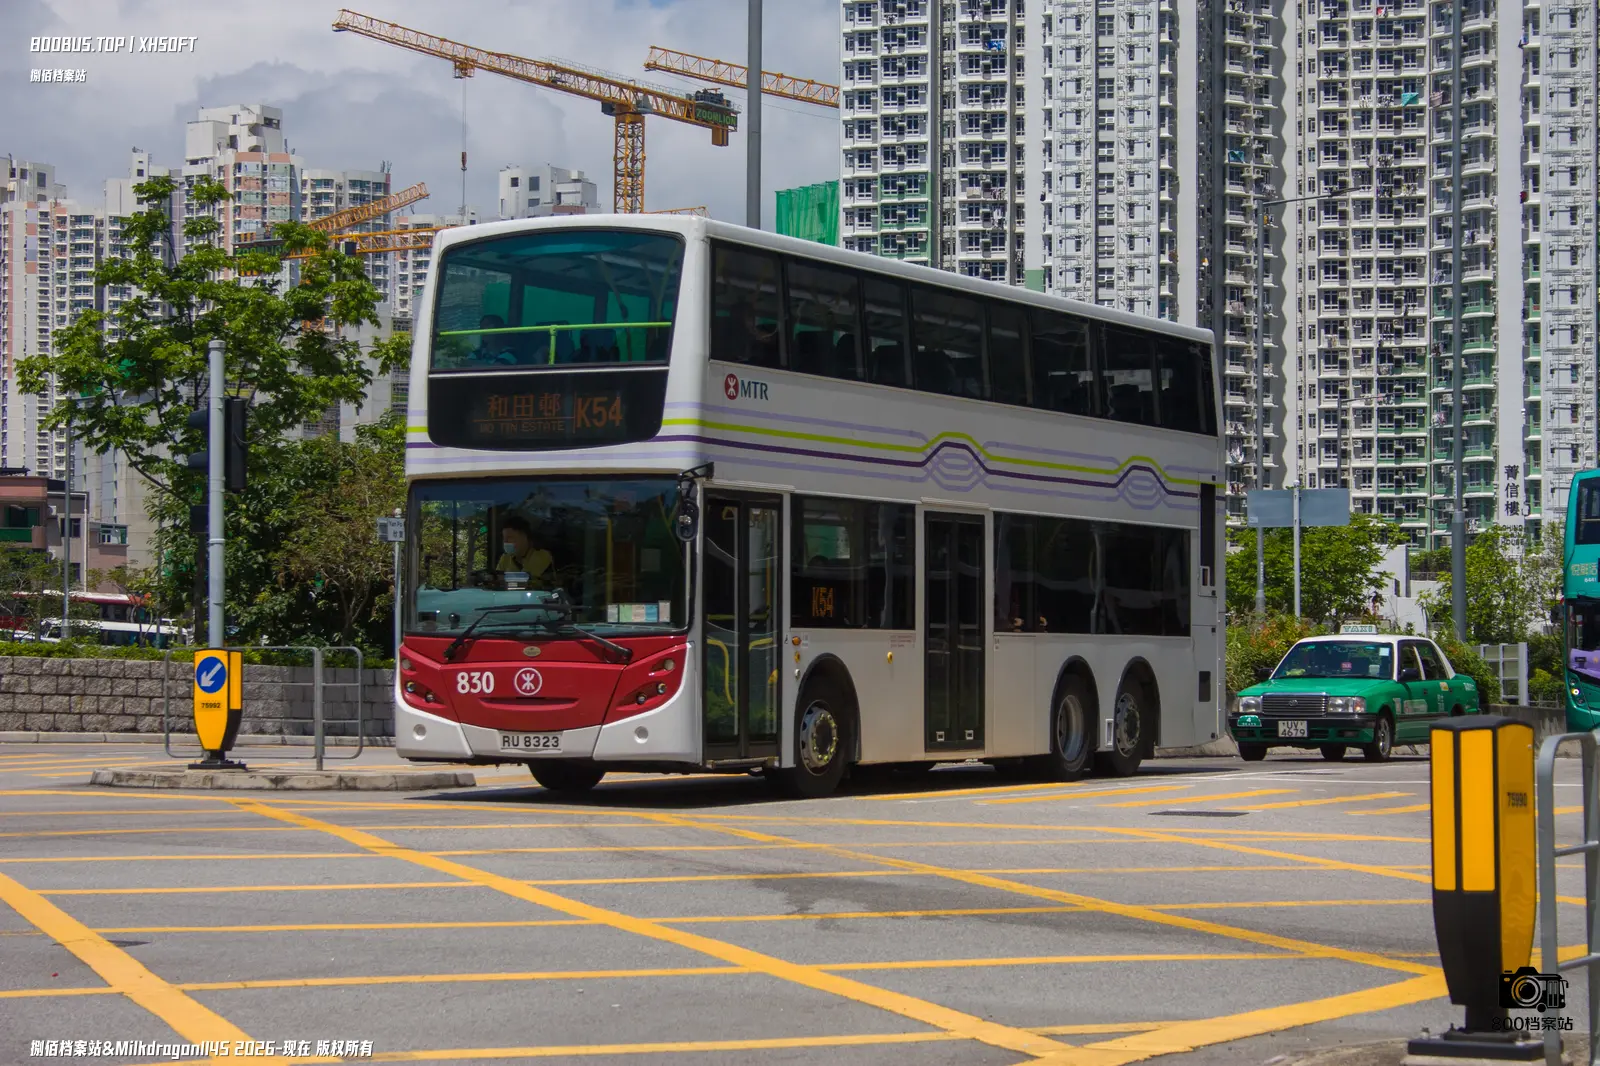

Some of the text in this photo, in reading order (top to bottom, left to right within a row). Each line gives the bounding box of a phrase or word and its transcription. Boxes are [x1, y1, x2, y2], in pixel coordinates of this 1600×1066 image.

[740, 379, 769, 401] MTR
[488, 393, 562, 418] 和田邨
[576, 397, 623, 428] K54
[521, 420, 566, 431] ESTATE
[812, 586, 834, 618] K54
[1343, 625, 1373, 633] TAXI
[457, 671, 495, 694] 830
[1281, 728, 1306, 737] 4679
[1286, 720, 1299, 729] UV
[502, 735, 560, 749] RU 8323
